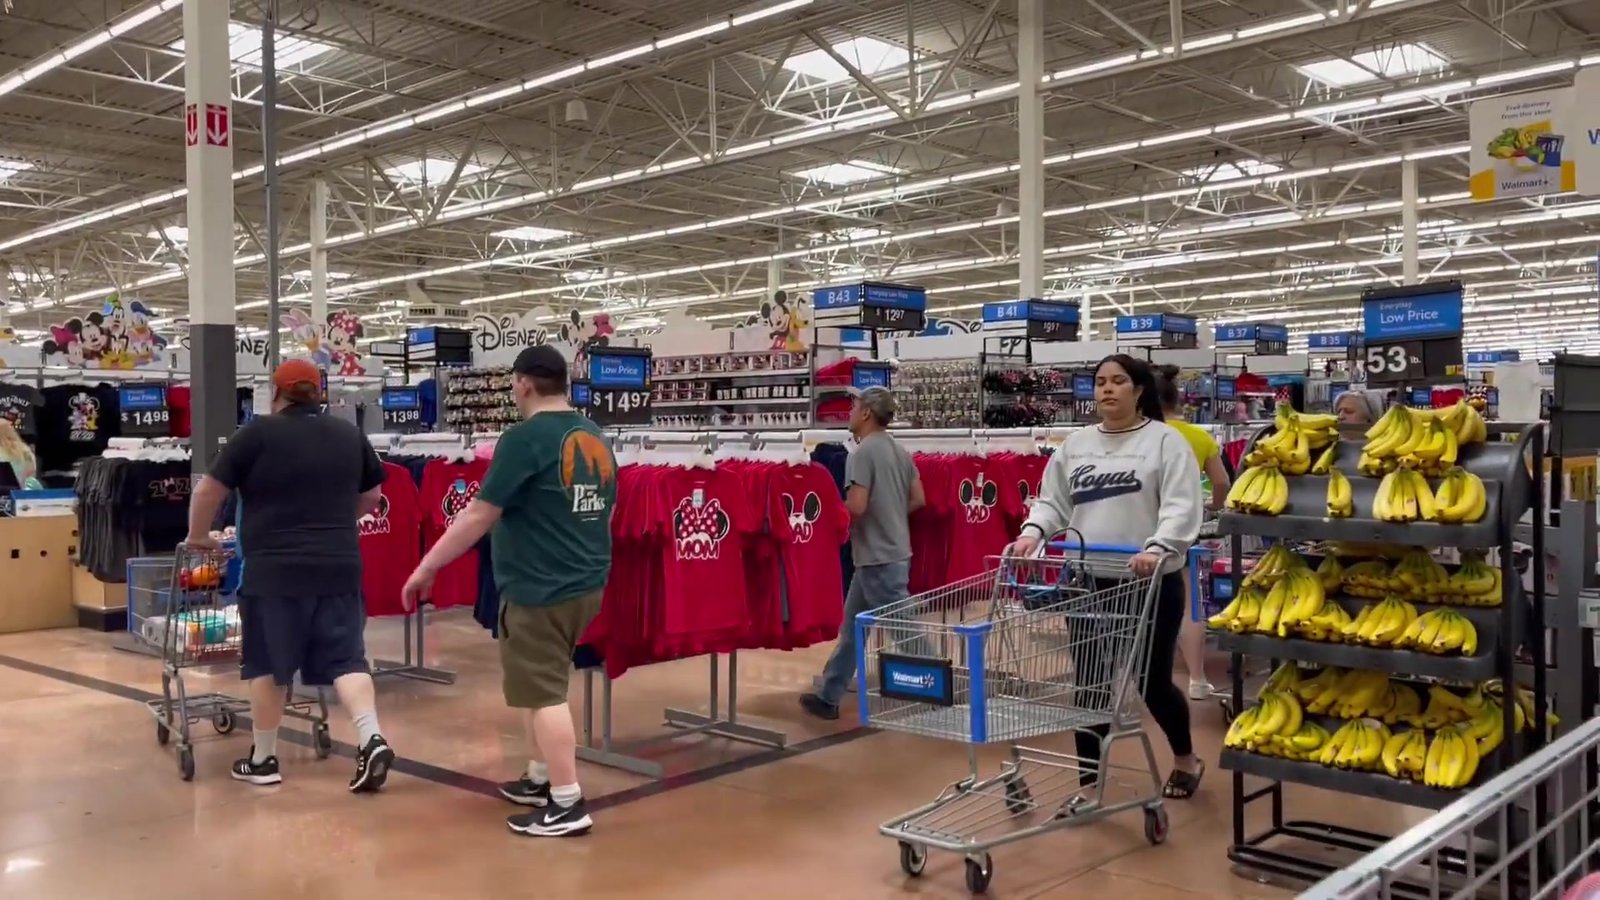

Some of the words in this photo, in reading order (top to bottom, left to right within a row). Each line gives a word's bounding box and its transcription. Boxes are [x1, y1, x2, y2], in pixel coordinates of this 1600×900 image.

[1380, 312, 1404, 324] Low
[1407, 309, 1439, 321] Price
[1367, 346, 1407, 373] 53
[601, 365, 617, 374] Low
[618, 365, 639, 375] Price
[790, 520, 813, 544] AD
[676, 537, 720, 561] MOM
[892, 671, 924, 684] Walmart
